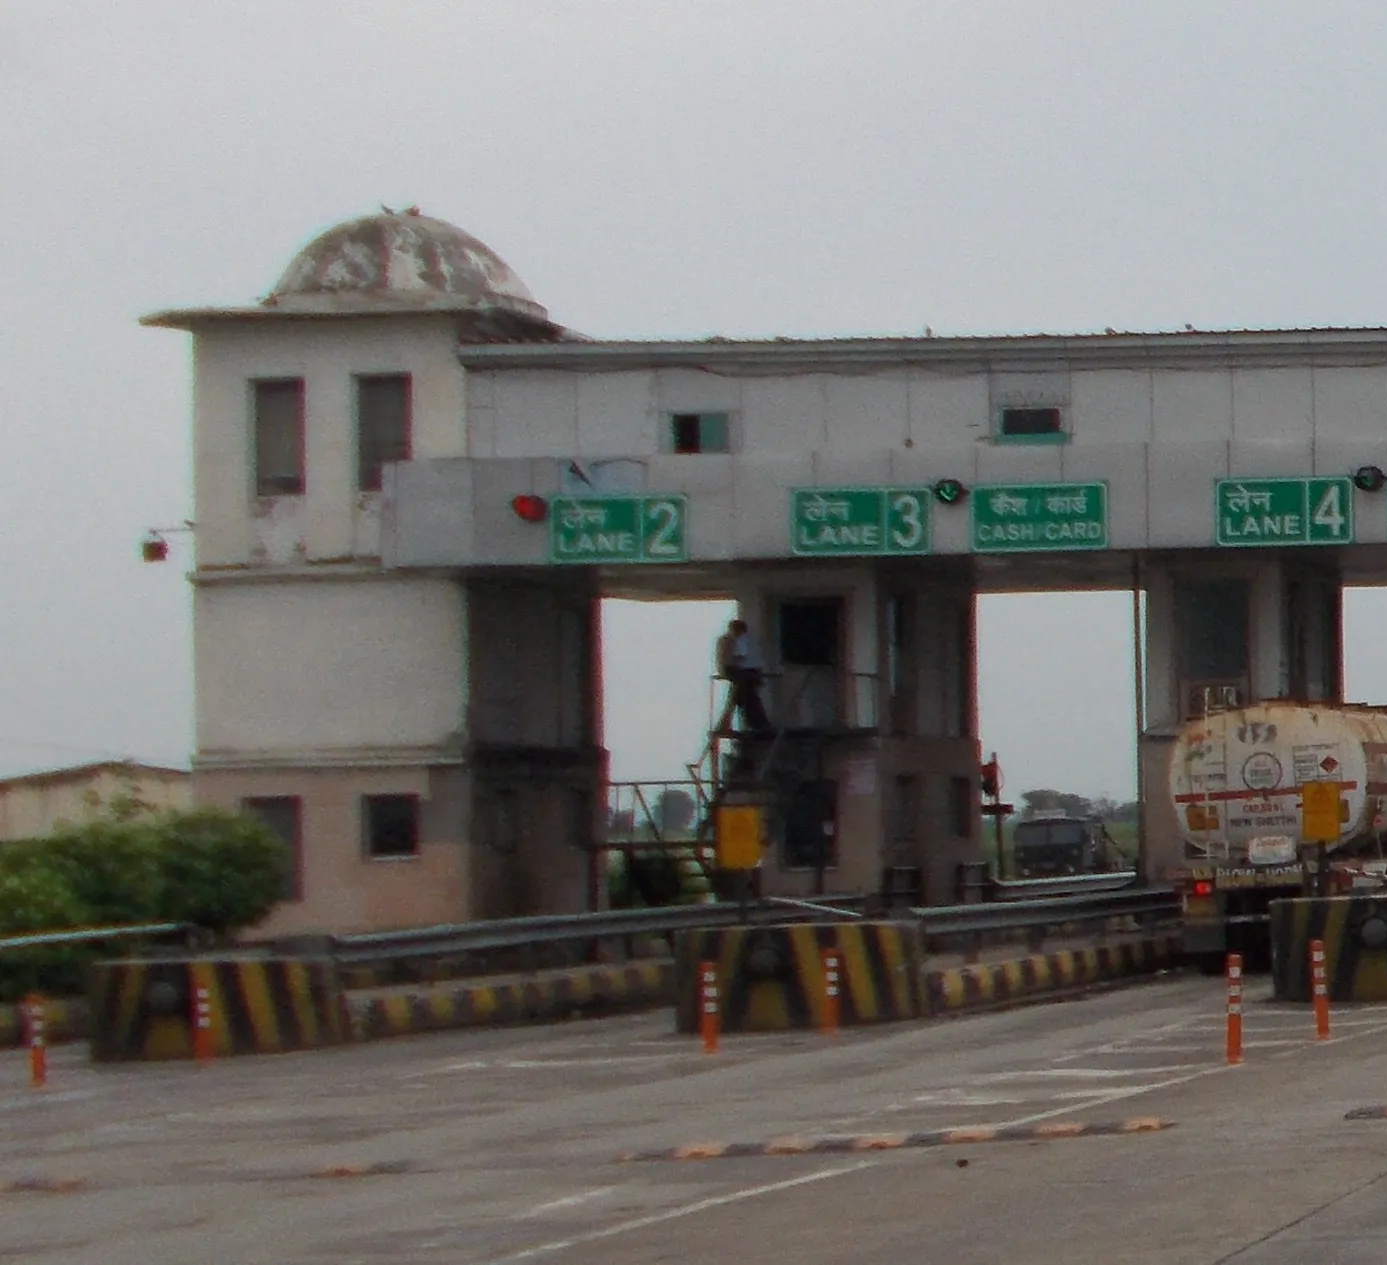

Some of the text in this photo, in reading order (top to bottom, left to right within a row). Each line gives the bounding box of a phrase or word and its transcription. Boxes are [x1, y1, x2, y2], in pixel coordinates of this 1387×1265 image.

[802, 494, 850, 522] लेन
[1046, 489, 1088, 514] कार्ड
[1225, 484, 1274, 513] लेन
[1312, 485, 1345, 536] 4
[560, 500, 608, 529] लेन
[648, 501, 679, 555] 2
[892, 494, 922, 547] 3
[1225, 515, 1301, 536] LANE
[558, 532, 634, 553] LANE
[801, 525, 880, 545] LANE
